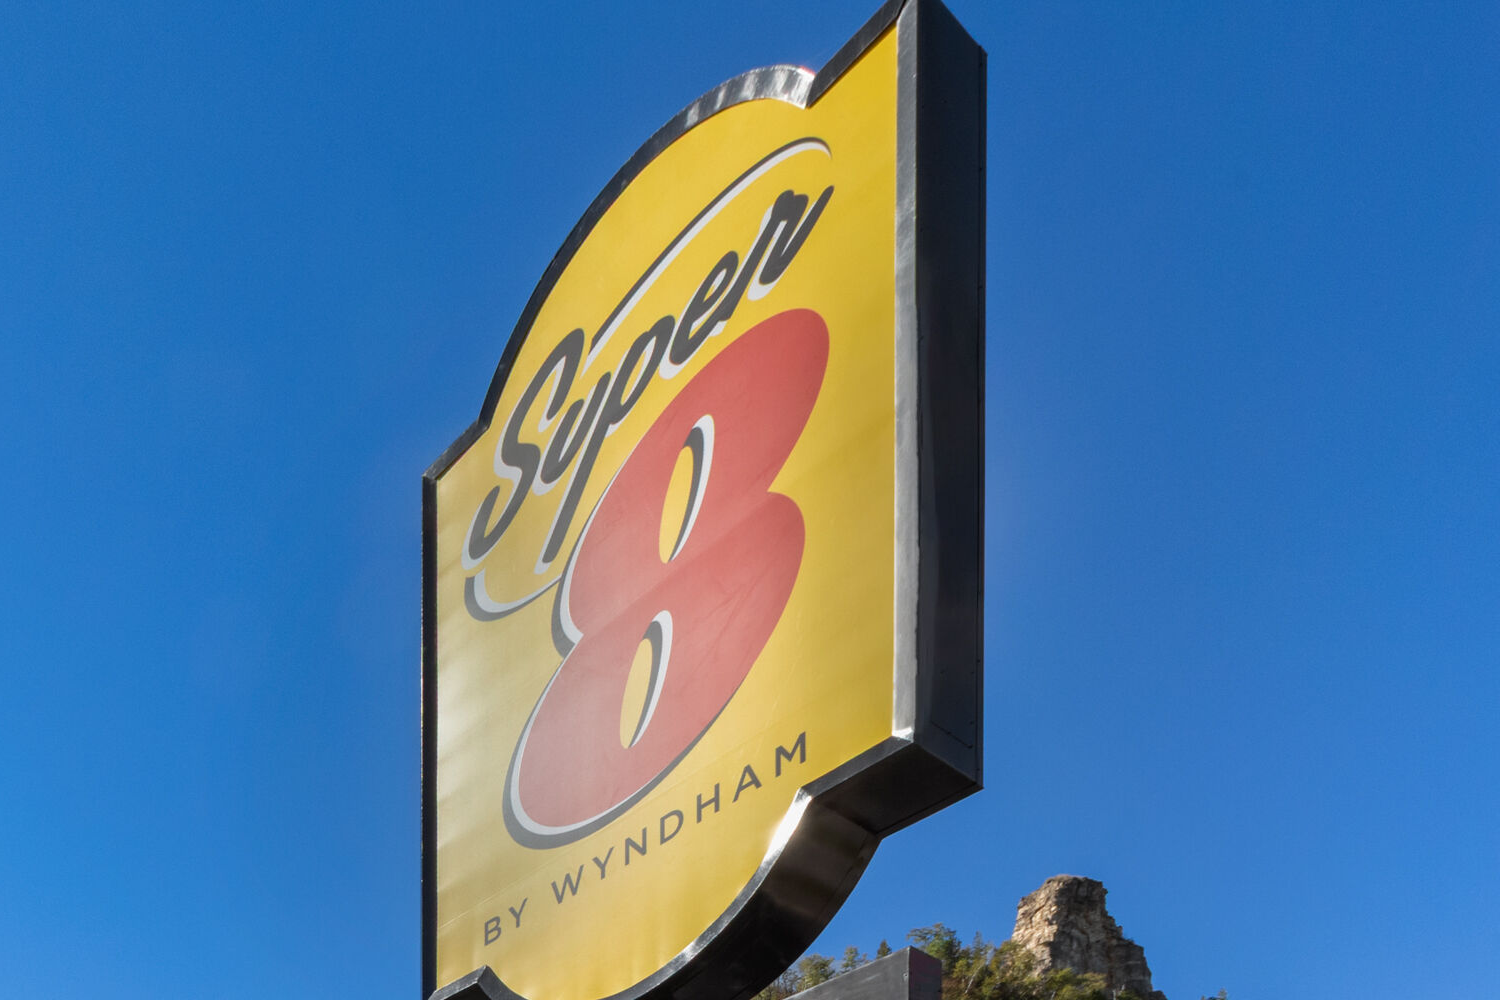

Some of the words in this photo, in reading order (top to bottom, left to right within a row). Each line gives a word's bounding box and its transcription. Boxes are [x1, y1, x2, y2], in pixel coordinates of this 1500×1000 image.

[463, 184, 835, 574] Super
[503, 307, 830, 850] 8
[482, 898, 528, 946] BY
[550, 731, 807, 904] WYNDHAM
